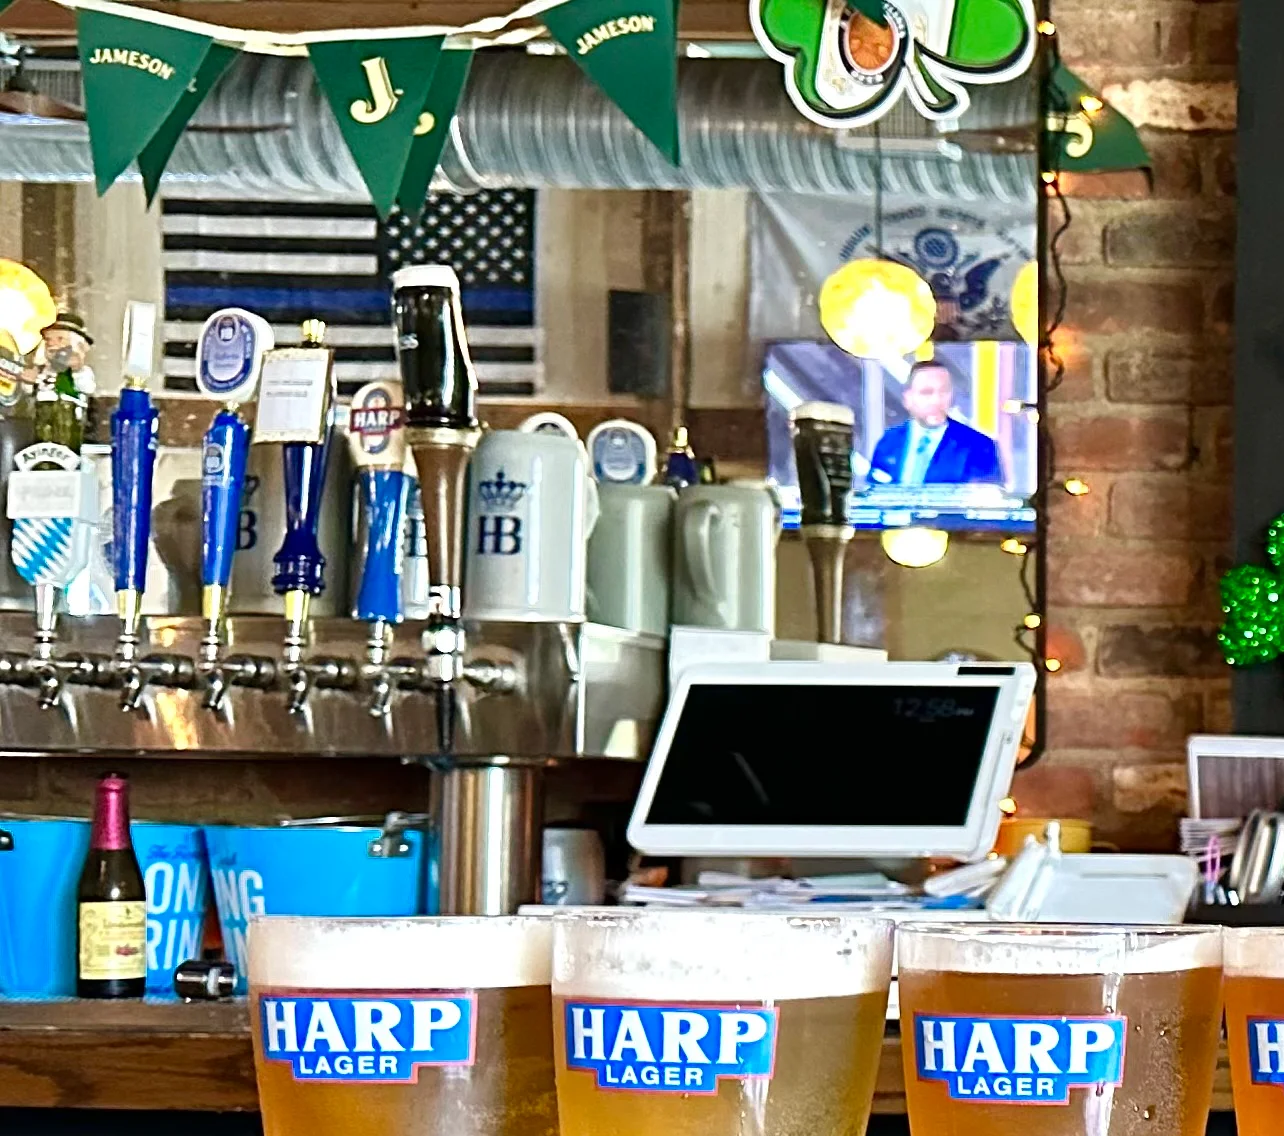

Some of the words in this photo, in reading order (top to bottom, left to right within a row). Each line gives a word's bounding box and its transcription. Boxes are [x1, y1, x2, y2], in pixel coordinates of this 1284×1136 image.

[576, 15, 656, 55] JAMESON
[89, 48, 176, 80] JAMESON
[350, 56, 398, 124] J
[354, 410, 400, 427] HARP
[264, 999, 462, 1052] HARP
[570, 1007, 769, 1064] HARP
[922, 1019, 1116, 1075] HARP
[299, 1055, 399, 1076] LAGER
[604, 1064, 704, 1087] LAGER
[956, 1076, 1055, 1097] LAGER
